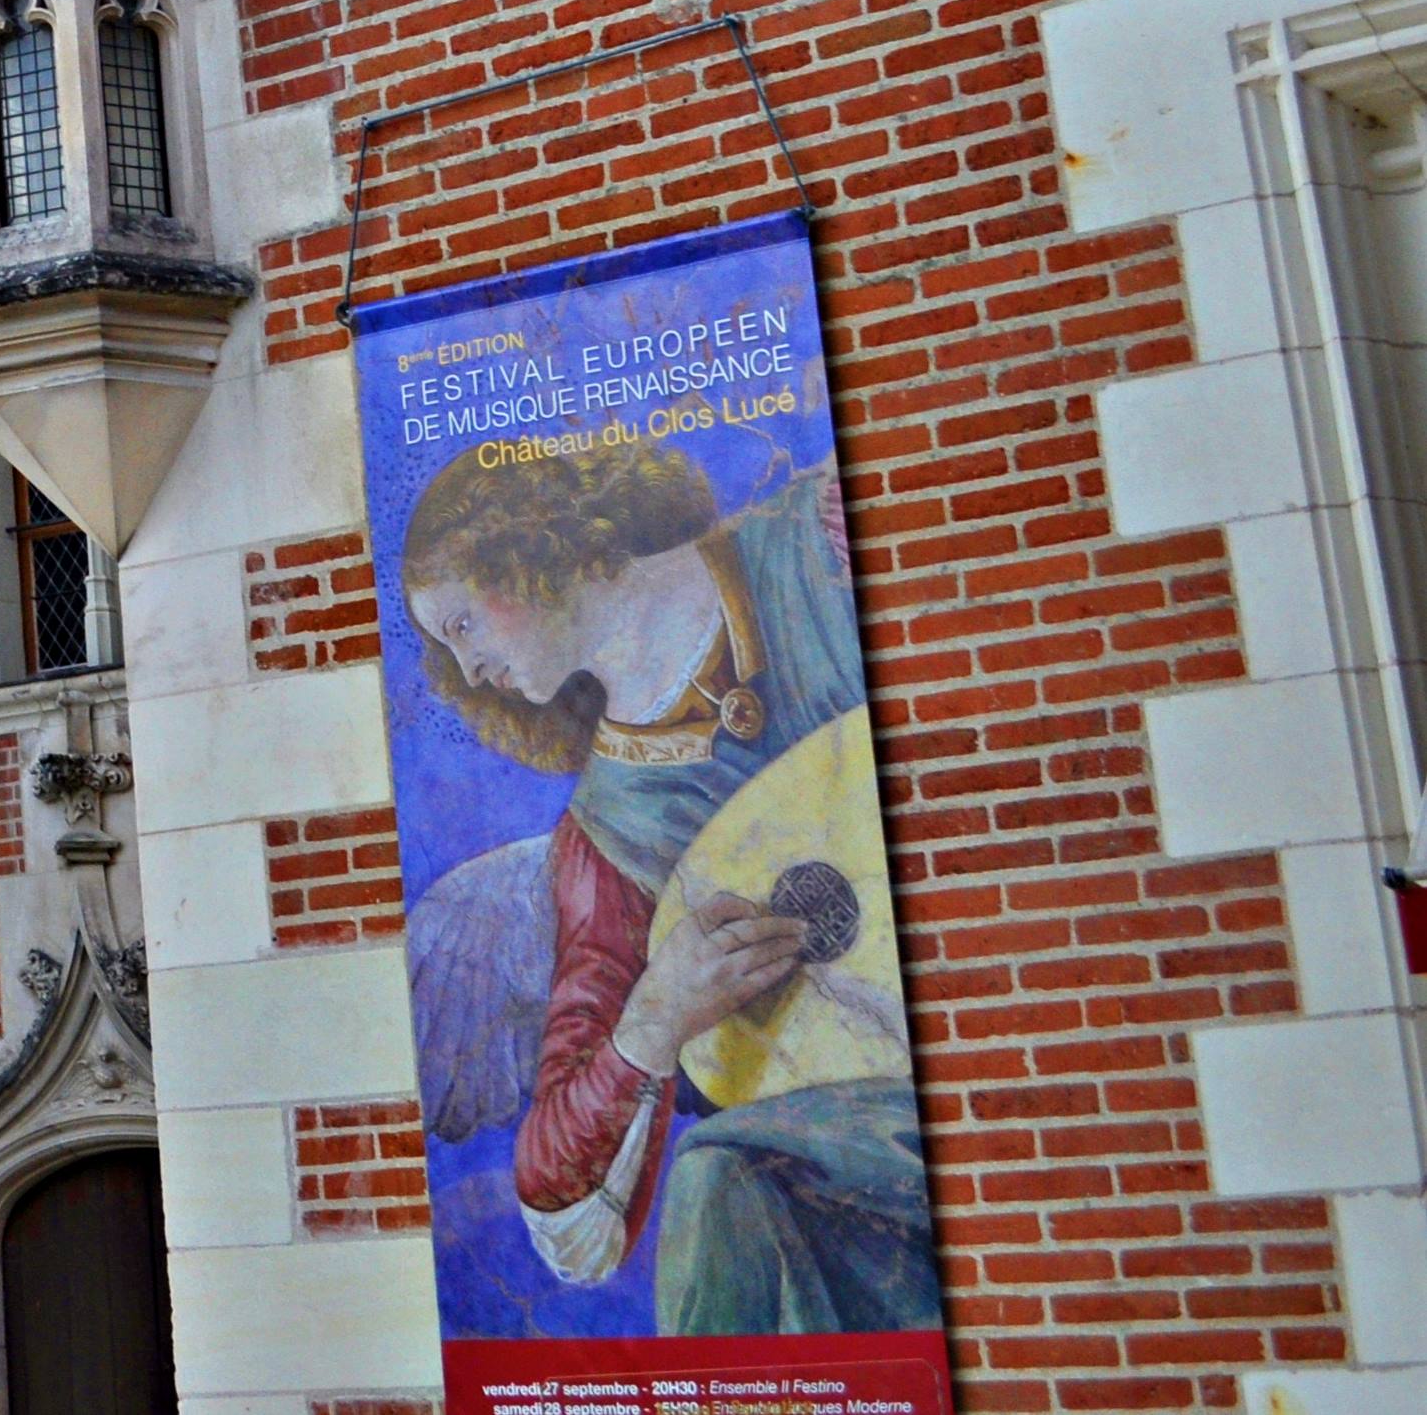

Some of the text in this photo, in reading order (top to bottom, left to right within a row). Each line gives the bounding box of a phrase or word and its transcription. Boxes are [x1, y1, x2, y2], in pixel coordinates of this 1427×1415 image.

[400, 306, 787, 410] FESTIVAL EUROPEEN
[404, 343, 793, 445] DE MUSIQUE RENAISSANCE
[477, 384, 796, 469] Château du Clos Lucé
[482, 1382, 541, 1396] vendredi
[543, 1382, 559, 1396] 27
[562, 1381, 638, 1398] septembre
[651, 1381, 697, 1396] 20H30
[709, 1380, 778, 1394] Ensemble
[793, 1378, 845, 1393] Festino
[493, 1402, 542, 1415] samedi
[544, 1402, 562, 1415] 28
[565, 1402, 640, 1415] septembre
[846, 1399, 912, 1414] Moderne
